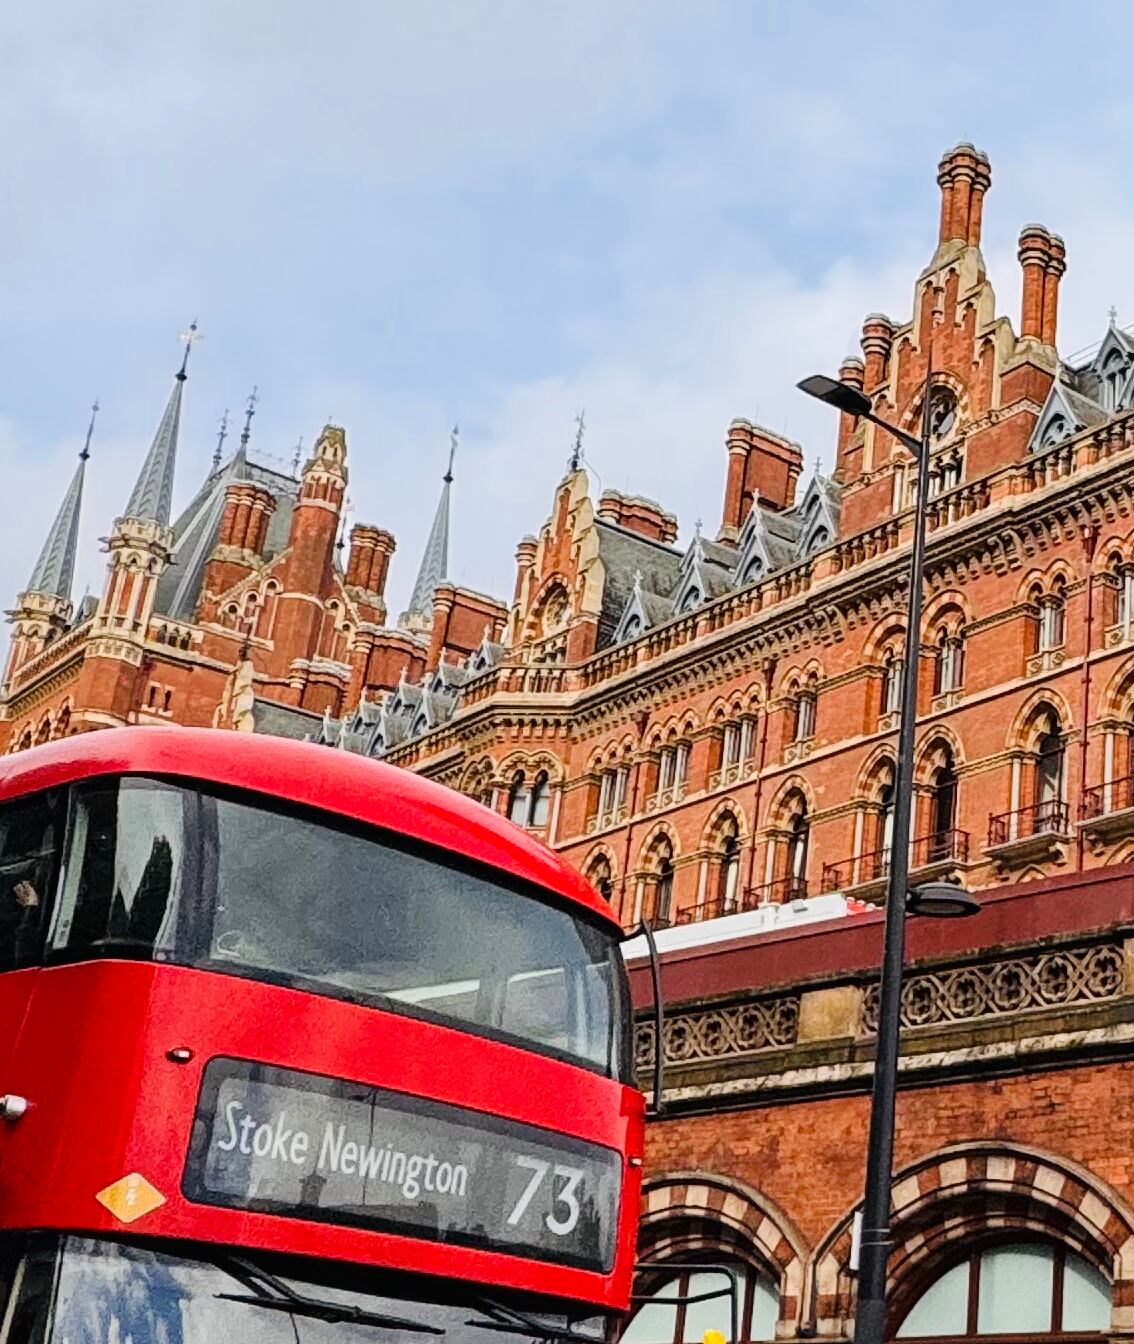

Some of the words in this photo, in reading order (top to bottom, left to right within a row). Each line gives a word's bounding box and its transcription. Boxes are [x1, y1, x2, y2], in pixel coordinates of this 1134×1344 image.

[218, 1100, 309, 1164] Stoke
[317, 1121, 469, 1200] Newington
[506, 1155, 585, 1236] 73
